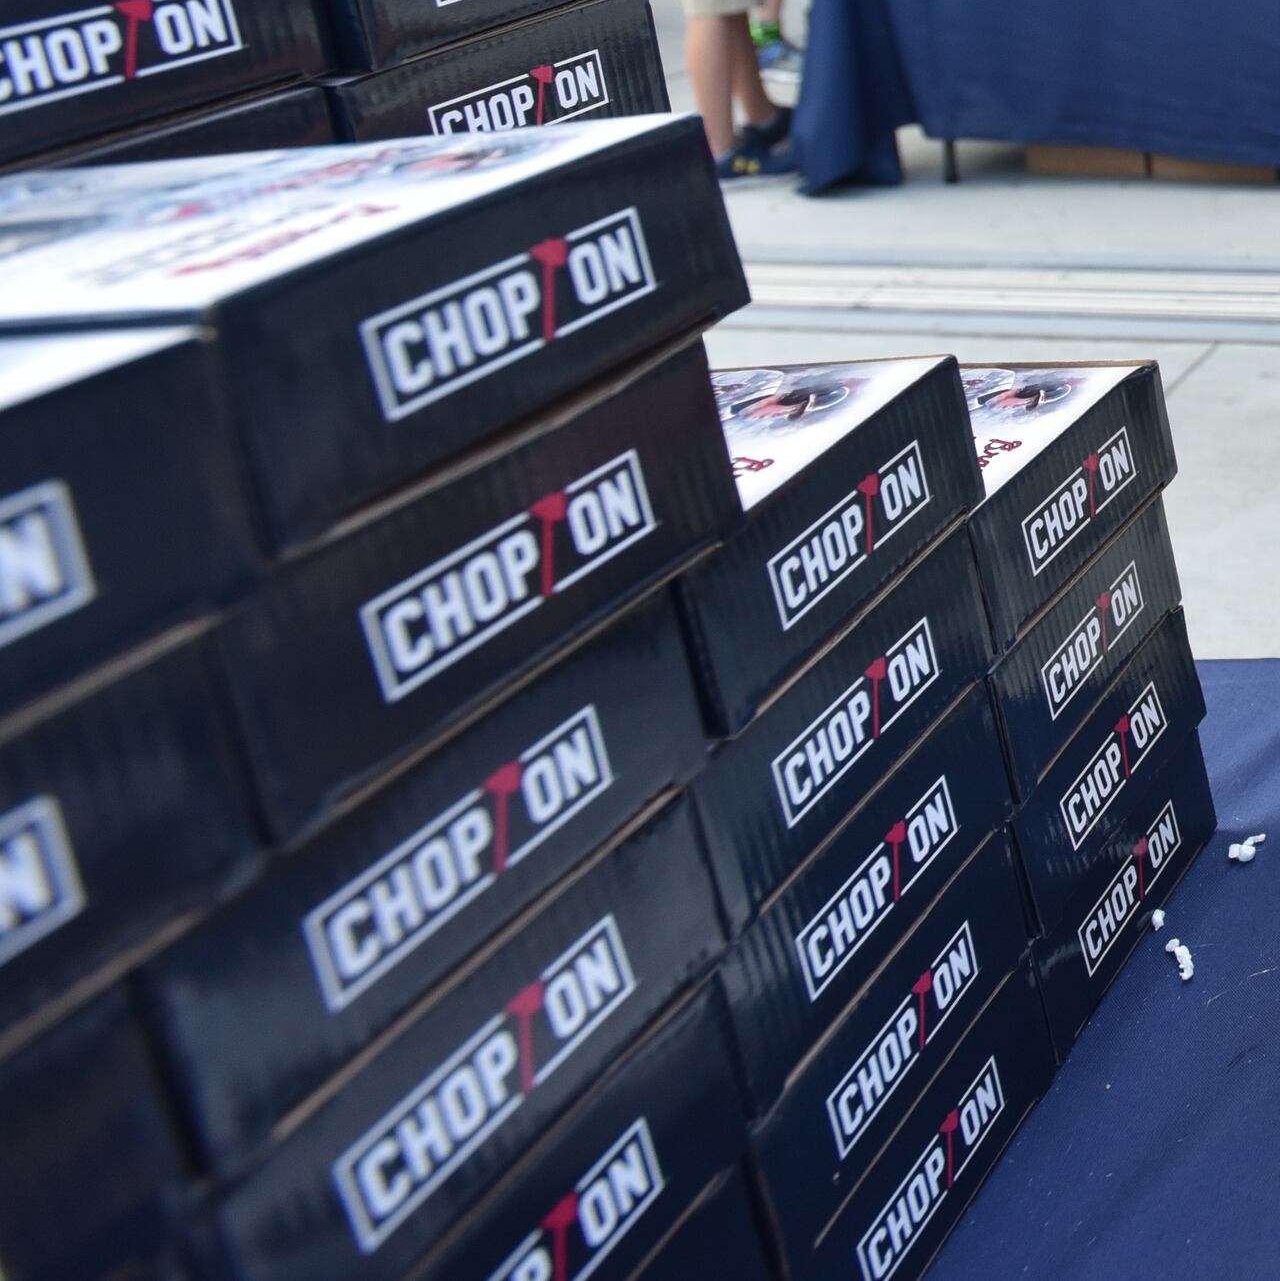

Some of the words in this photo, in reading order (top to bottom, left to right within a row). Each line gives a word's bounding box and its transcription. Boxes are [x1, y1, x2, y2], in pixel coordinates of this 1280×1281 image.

[555, 61, 602, 109] ON
[378, 269, 539, 395] CHOP
[568, 222, 643, 307] ON
[381, 528, 541, 674] CHOP
[565, 469, 642, 557] ON
[779, 502, 865, 619] CHOP
[879, 463, 927, 523] ON
[1028, 486, 1090, 562] CHOP
[1097, 443, 1134, 495] ON
[783, 693, 871, 808] CHOP
[887, 640, 936, 703] ON
[1048, 615, 1103, 706] CHOP
[1110, 576, 1141, 628] ON
[1064, 740, 1122, 836] CHOP
[1130, 696, 1163, 753] ON
[321, 806, 496, 981] CHOP
[518, 734, 598, 824] ON
[805, 855, 892, 979] CHOP
[906, 798, 953, 864] ON
[1081, 864, 1139, 959] CHOP
[1146, 814, 1177, 871] ON
[354, 1028, 520, 1220] CHOP
[541, 935, 621, 1039] ON
[834, 1007, 919, 1136] CHOP
[931, 935, 974, 1012] ON
[577, 1139, 650, 1250] ON
[866, 1146, 946, 1281] CHOP
[958, 1075, 1001, 1148] ON
